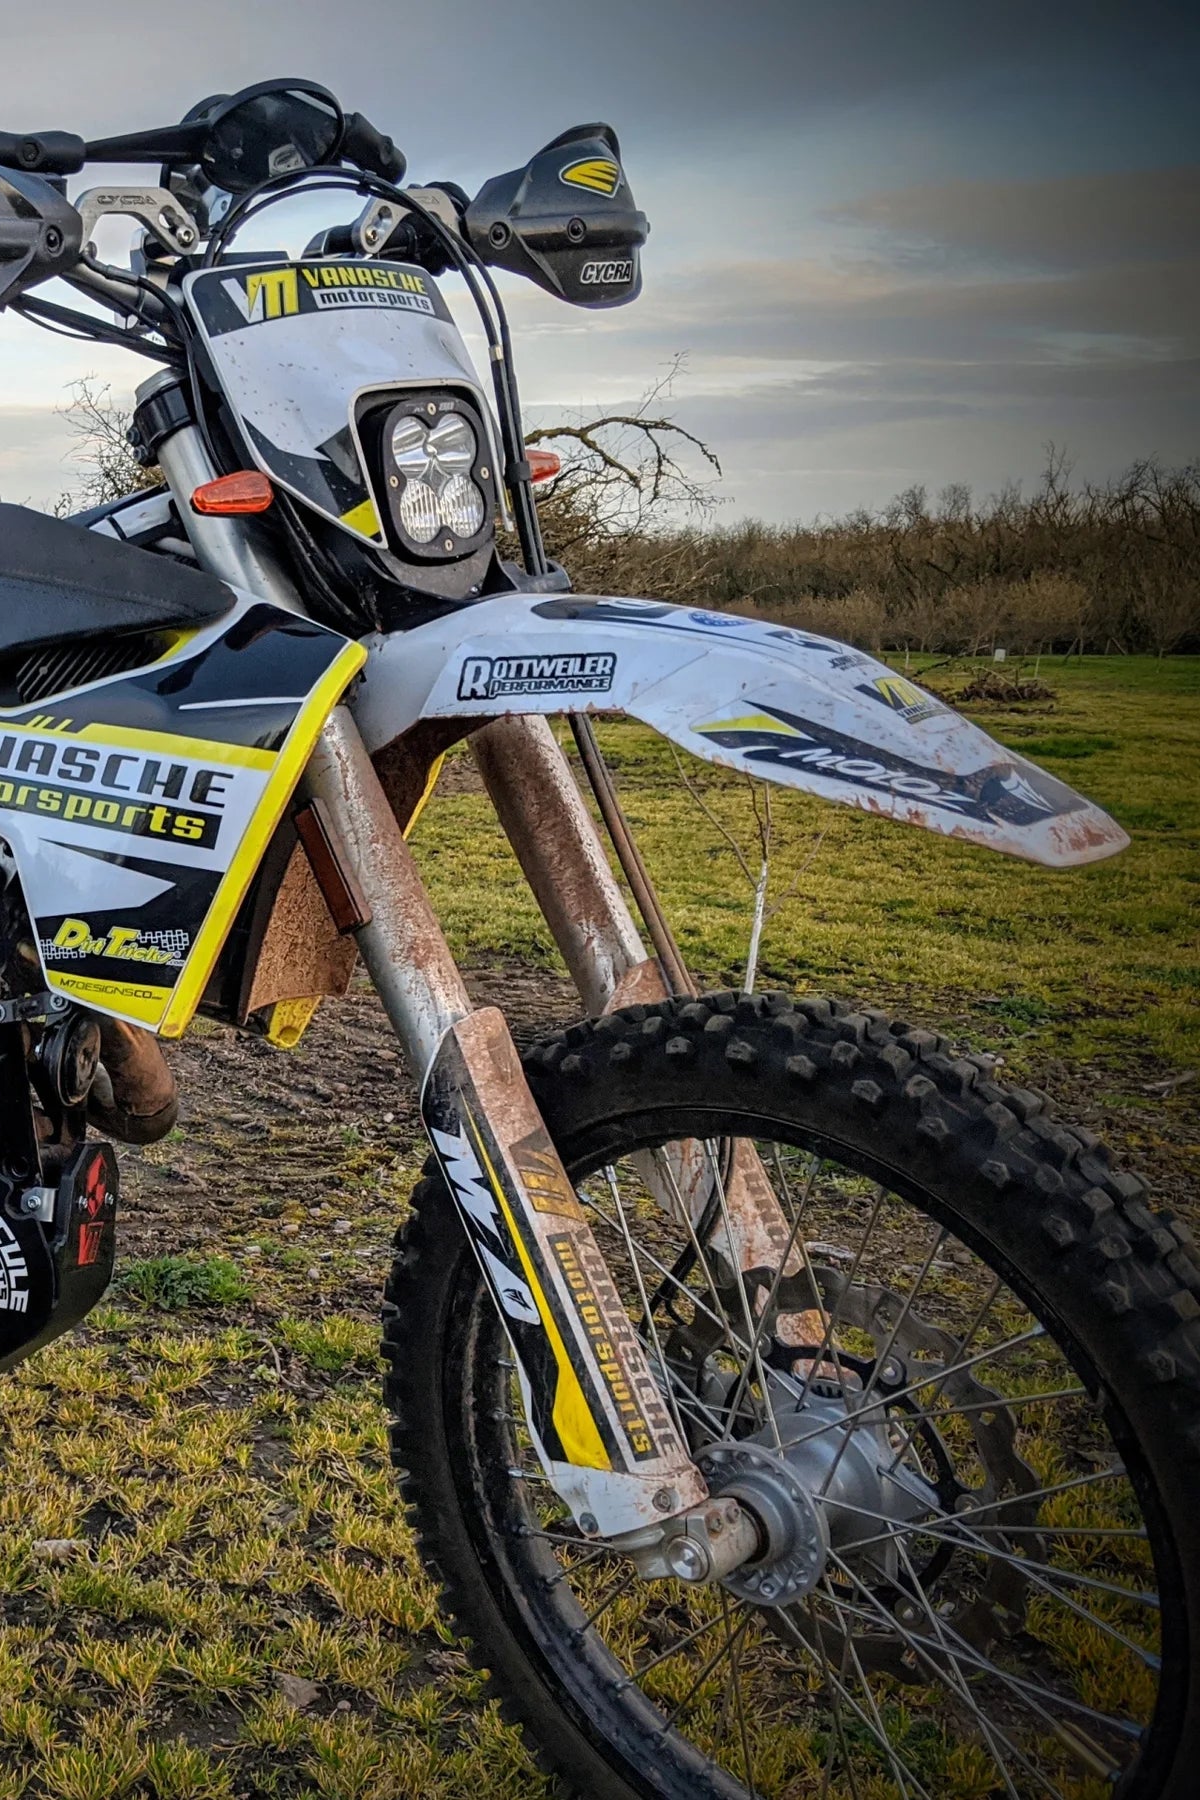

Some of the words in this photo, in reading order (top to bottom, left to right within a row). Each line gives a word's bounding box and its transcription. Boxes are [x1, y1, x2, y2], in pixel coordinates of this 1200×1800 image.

[96, 195, 157, 205] CYCRA
[302, 267, 428, 295] VANASCHE
[580, 260, 634, 284] CYCRA
[320, 289, 430, 310] motorsports
[459, 655, 616, 698] ROTTWEILER
[489, 677, 611, 697] PERFORMANCE
[555, 1241, 652, 1453] motorsports
[575, 1228, 679, 1455] VANASCHE
